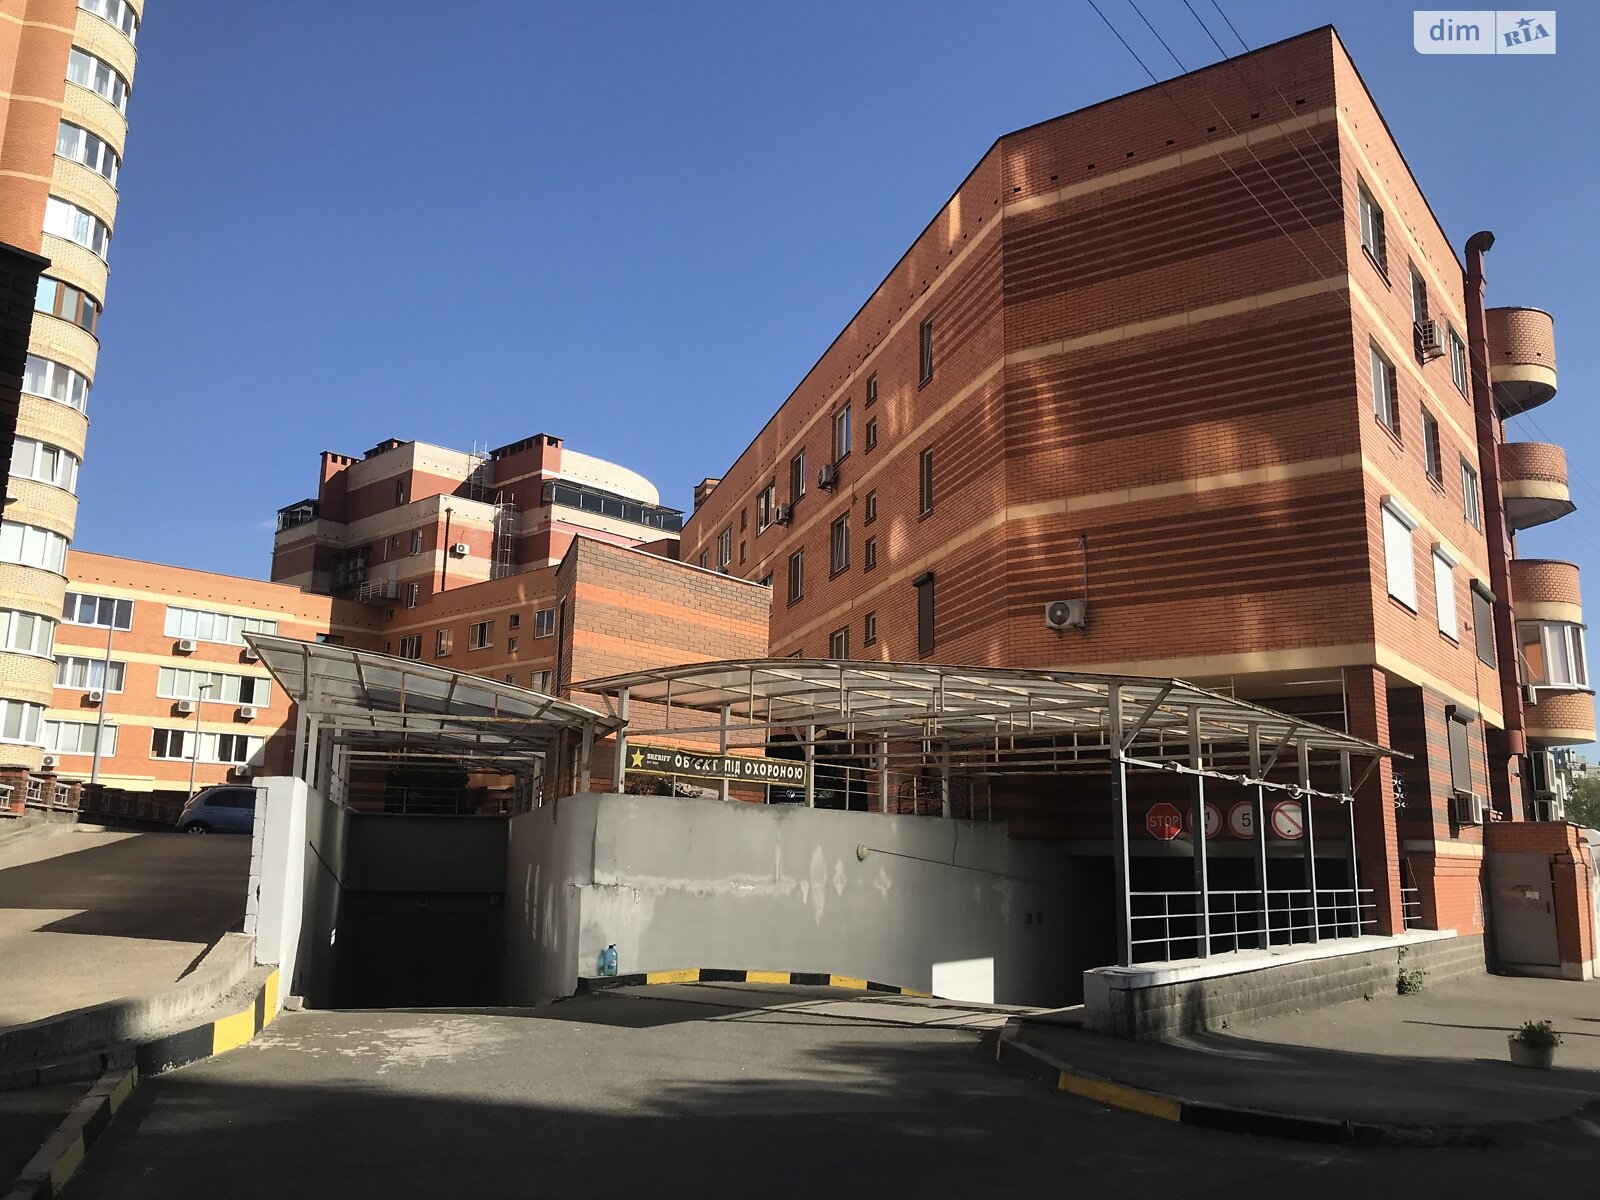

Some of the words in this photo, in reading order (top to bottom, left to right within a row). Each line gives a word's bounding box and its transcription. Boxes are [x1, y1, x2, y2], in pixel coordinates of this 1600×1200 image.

[646, 753, 671, 762] SHERIFF
[724, 759, 740, 775] ПІД
[745, 762, 803, 780] ОХОРОНОЮ
[1149, 815, 1179, 828] STOP
[1241, 813, 1251, 827] 5
